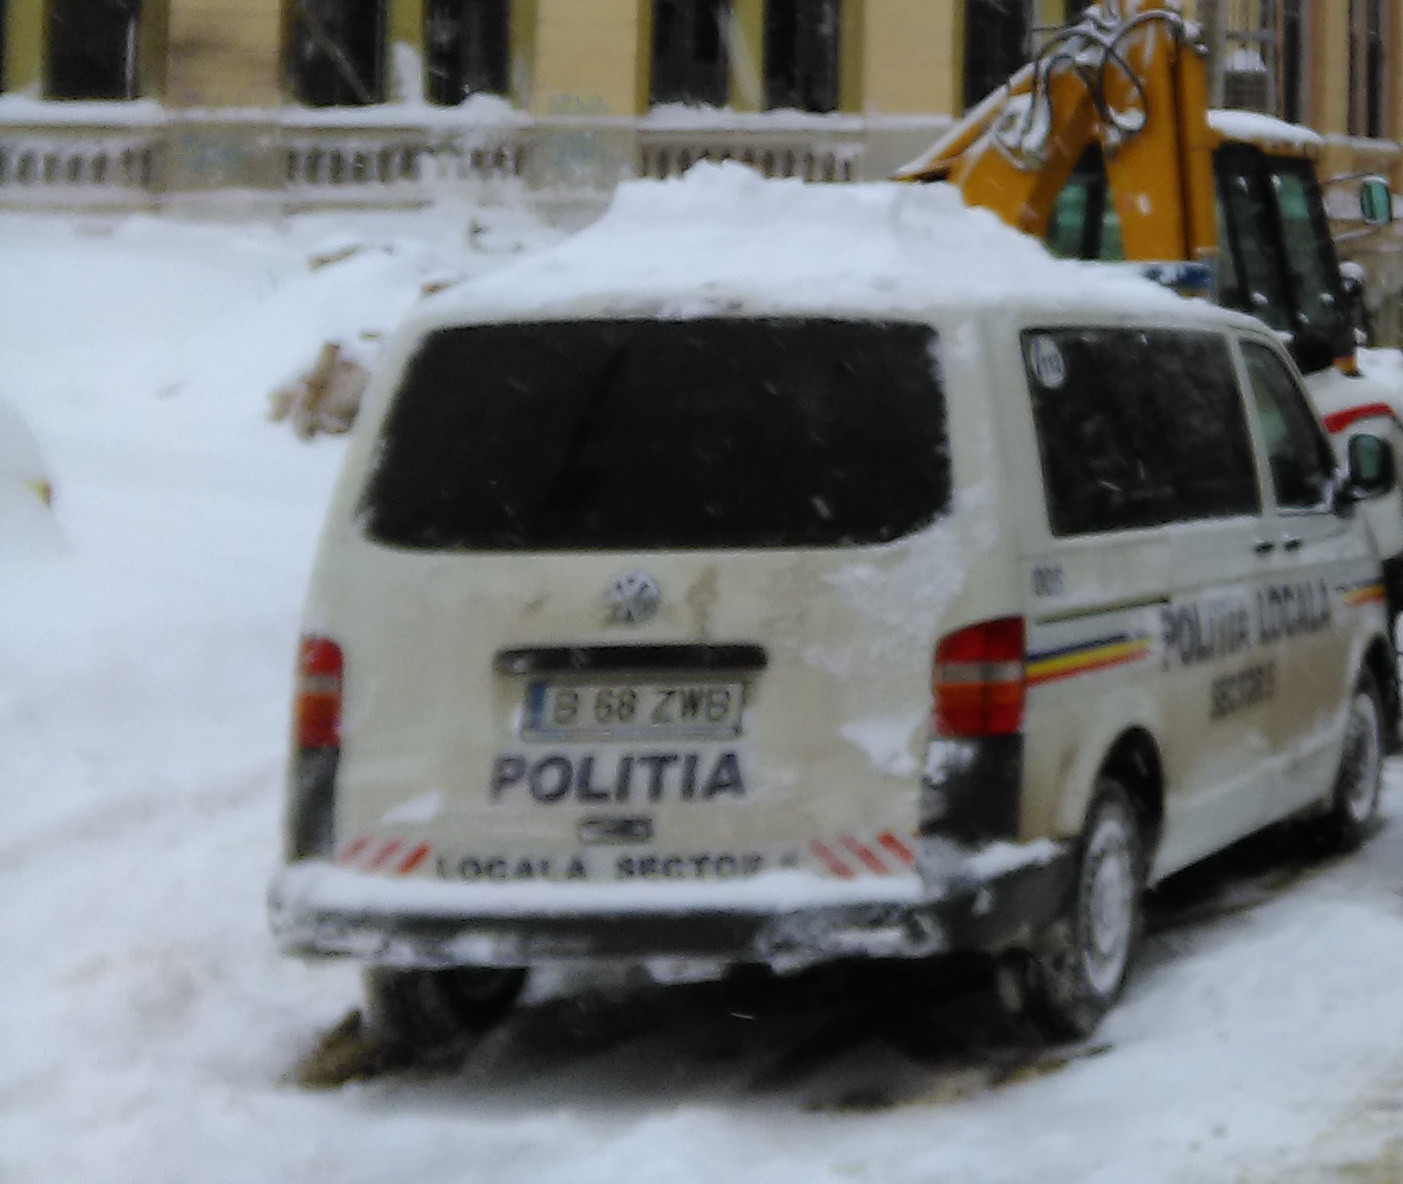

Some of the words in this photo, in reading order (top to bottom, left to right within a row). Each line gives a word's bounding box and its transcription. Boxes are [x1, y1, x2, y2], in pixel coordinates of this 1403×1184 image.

[555, 688, 579, 724] B
[651, 687, 731, 725] ZWB
[488, 752, 746, 803] POLITIA
